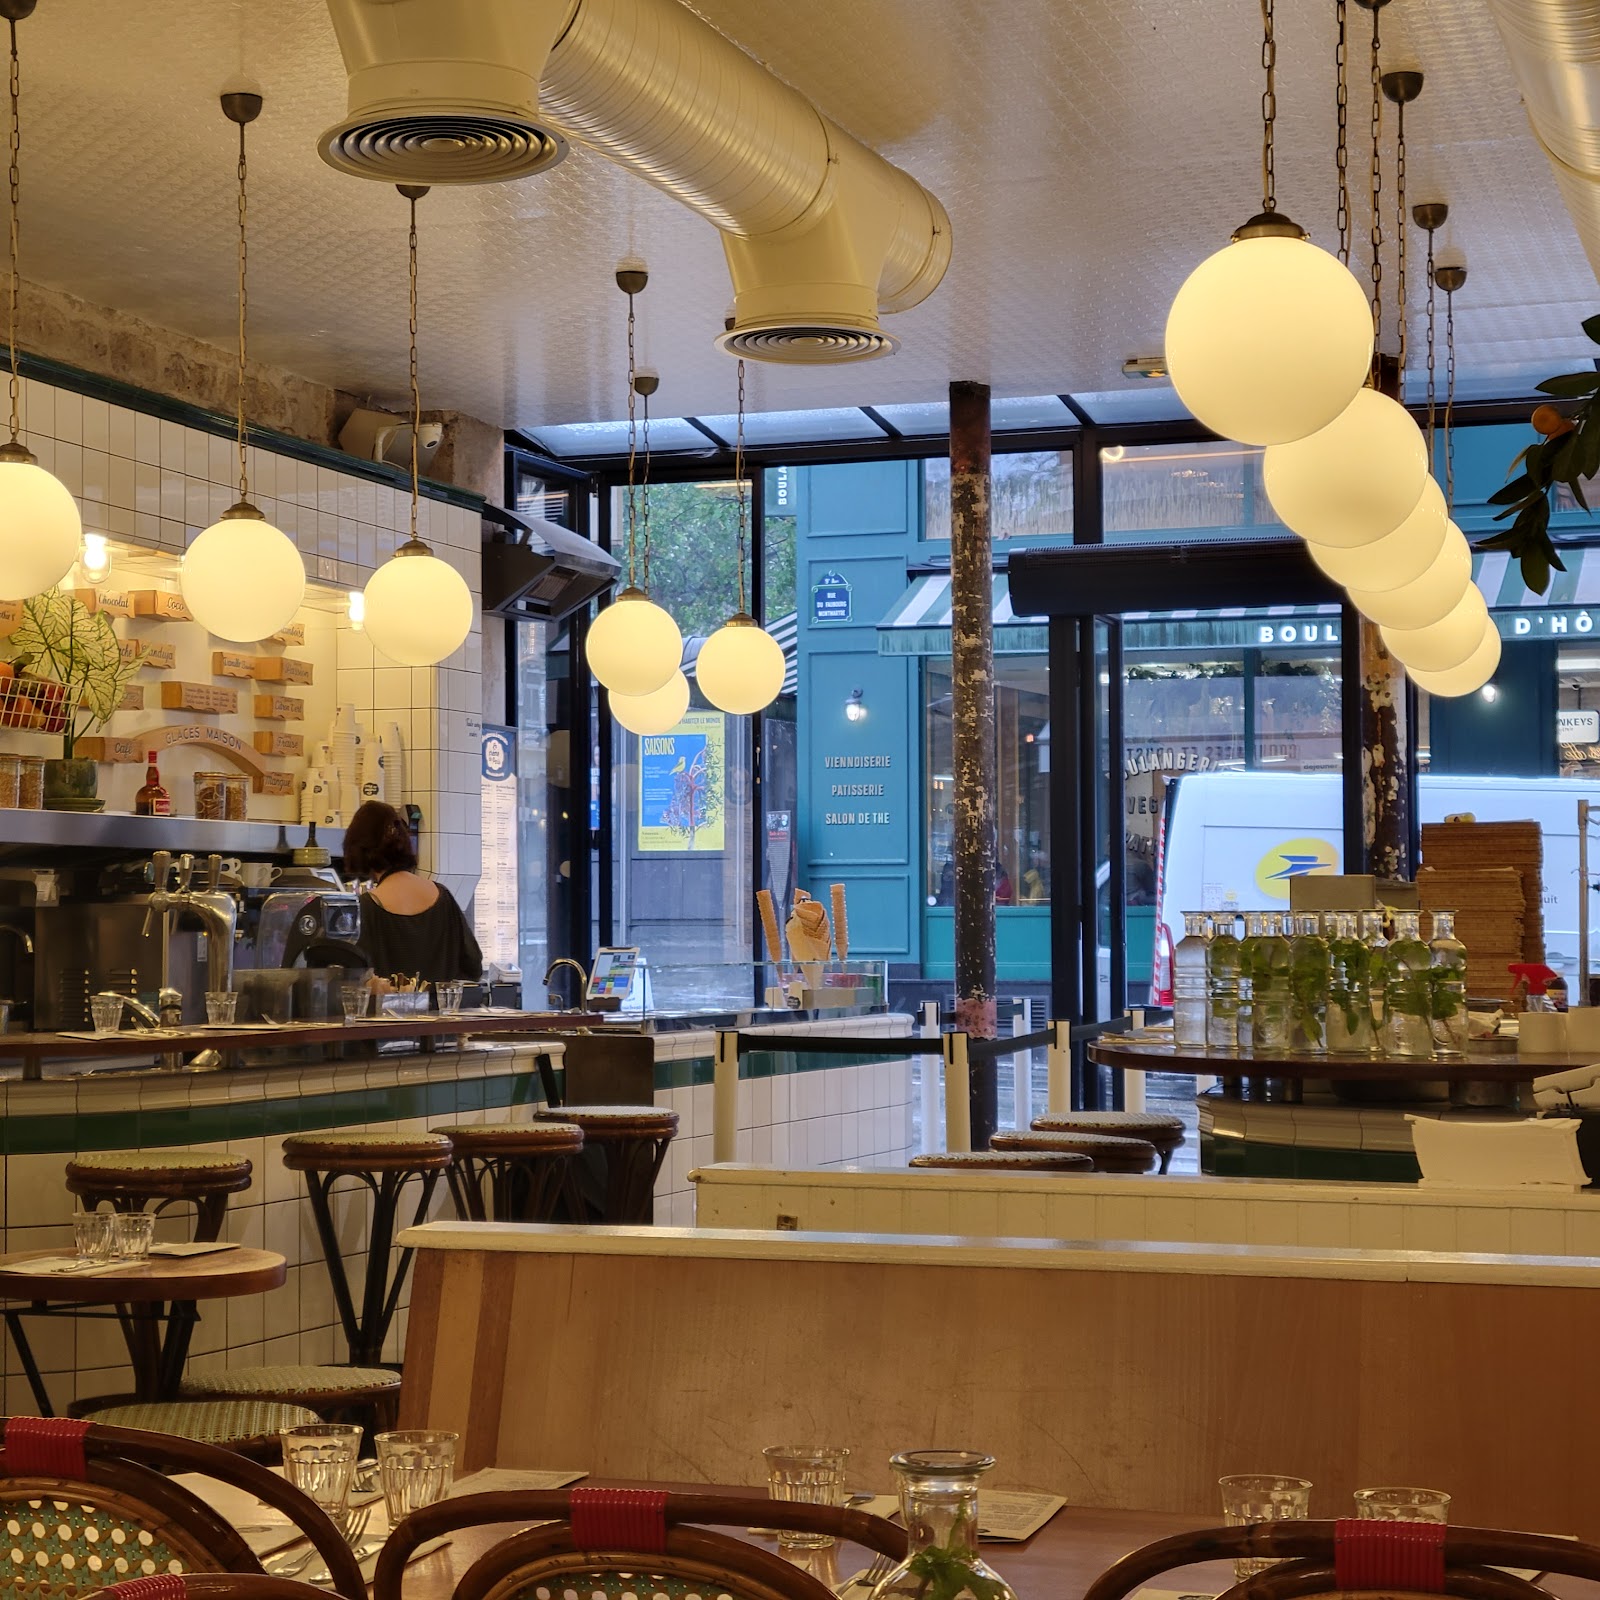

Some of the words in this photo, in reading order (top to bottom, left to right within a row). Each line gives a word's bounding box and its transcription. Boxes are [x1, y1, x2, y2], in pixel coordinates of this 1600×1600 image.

[98, 593, 129, 608] Chocolat
[167, 597, 184, 611] Coco
[1260, 625, 1338, 642] BOUL
[166, 726, 200, 744] GLACES
[206, 727, 242, 750] MAISON
[644, 738, 675, 756] SAISONS
[824, 756, 891, 768] VIENNOISERIE
[831, 784, 884, 796] PATISSERIE
[825, 813, 855, 825] SALON
[858, 813, 870, 824] DE
[872, 812, 890, 824] THE
